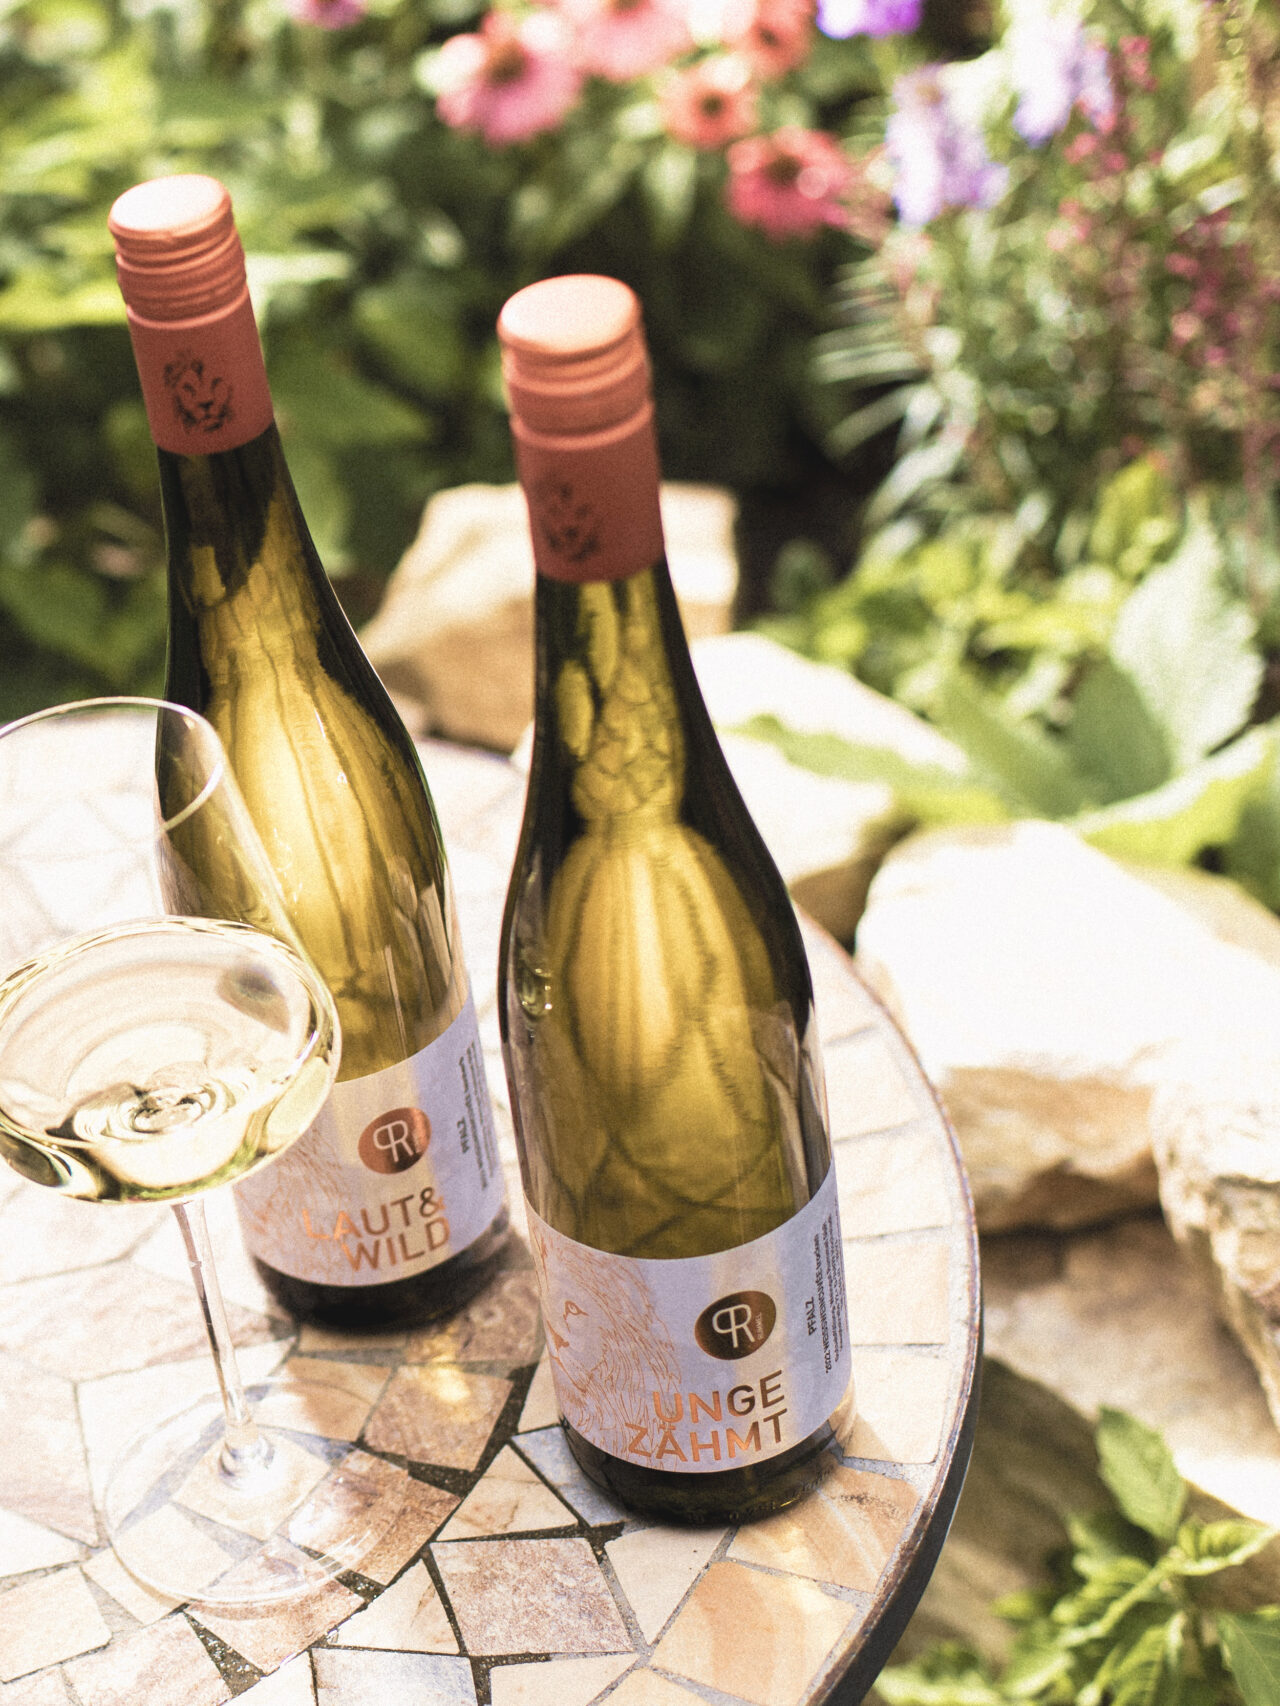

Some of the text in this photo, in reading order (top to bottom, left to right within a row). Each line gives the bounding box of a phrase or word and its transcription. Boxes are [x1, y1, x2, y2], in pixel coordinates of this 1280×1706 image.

[302, 1187, 446, 1240] LAUT&
[341, 1216, 450, 1271] WILD
[805, 1296, 817, 1336] PFALZ
[652, 1369, 785, 1423] UNGE
[624, 1408, 788, 1462] ZÄHMT
